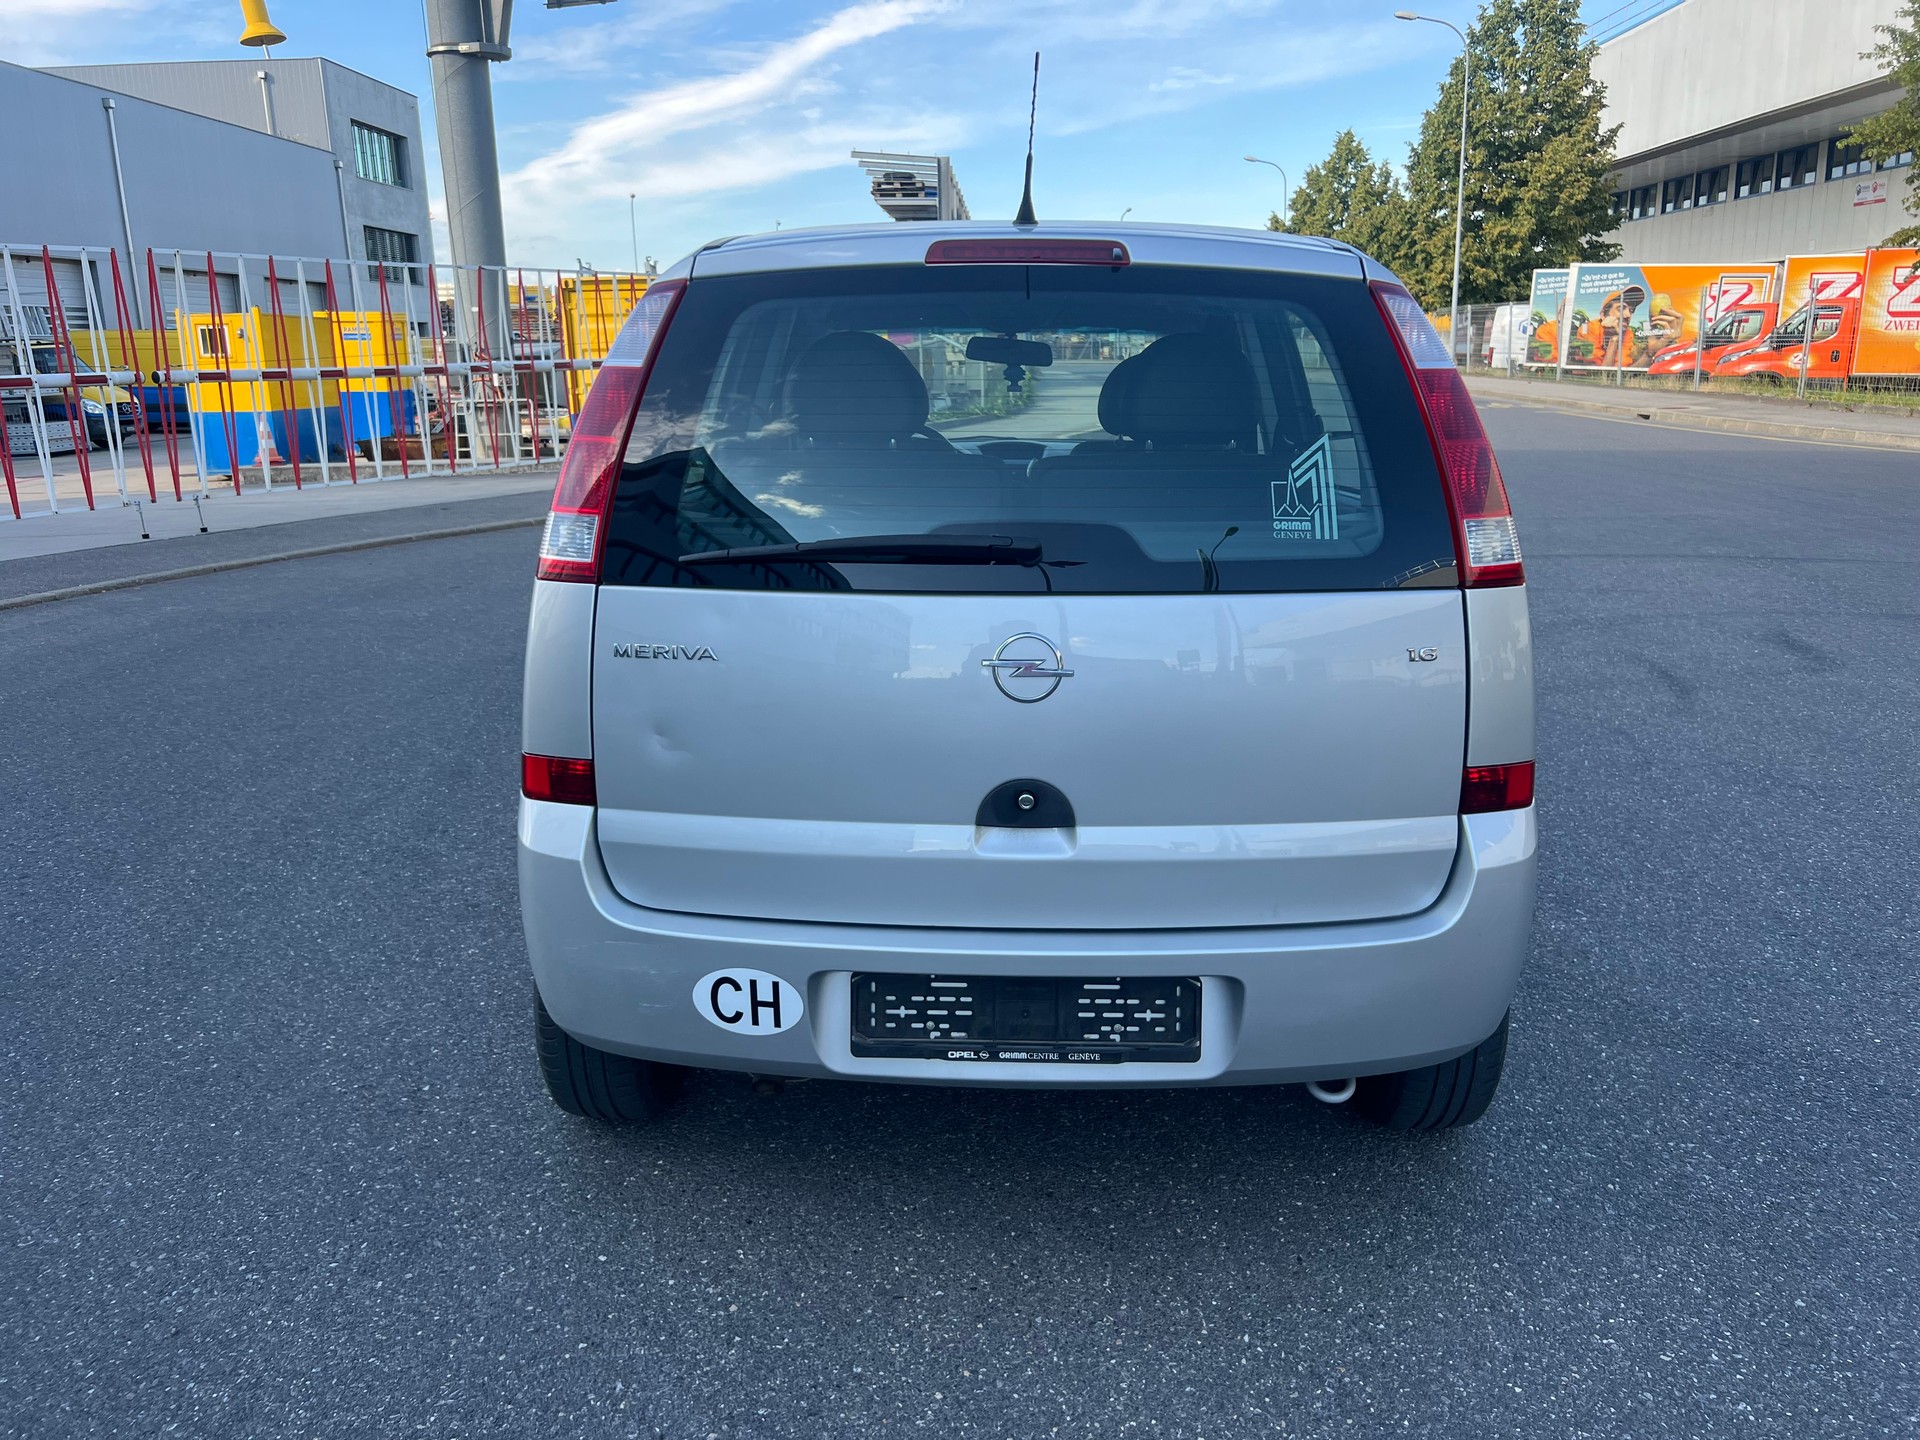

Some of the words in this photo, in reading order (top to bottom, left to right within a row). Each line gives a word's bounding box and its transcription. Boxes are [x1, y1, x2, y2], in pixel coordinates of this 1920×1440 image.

[1593, 279, 1612, 287] devenir
[1612, 277, 1630, 285] quand
[1273, 521, 1312, 530] GRIMM
[1273, 530, 1313, 539] GENEVE
[613, 642, 719, 661] MERIVA
[1406, 647, 1438, 662] 1.6
[710, 976, 782, 1029] CH
[948, 1051, 977, 1059] OPEL
